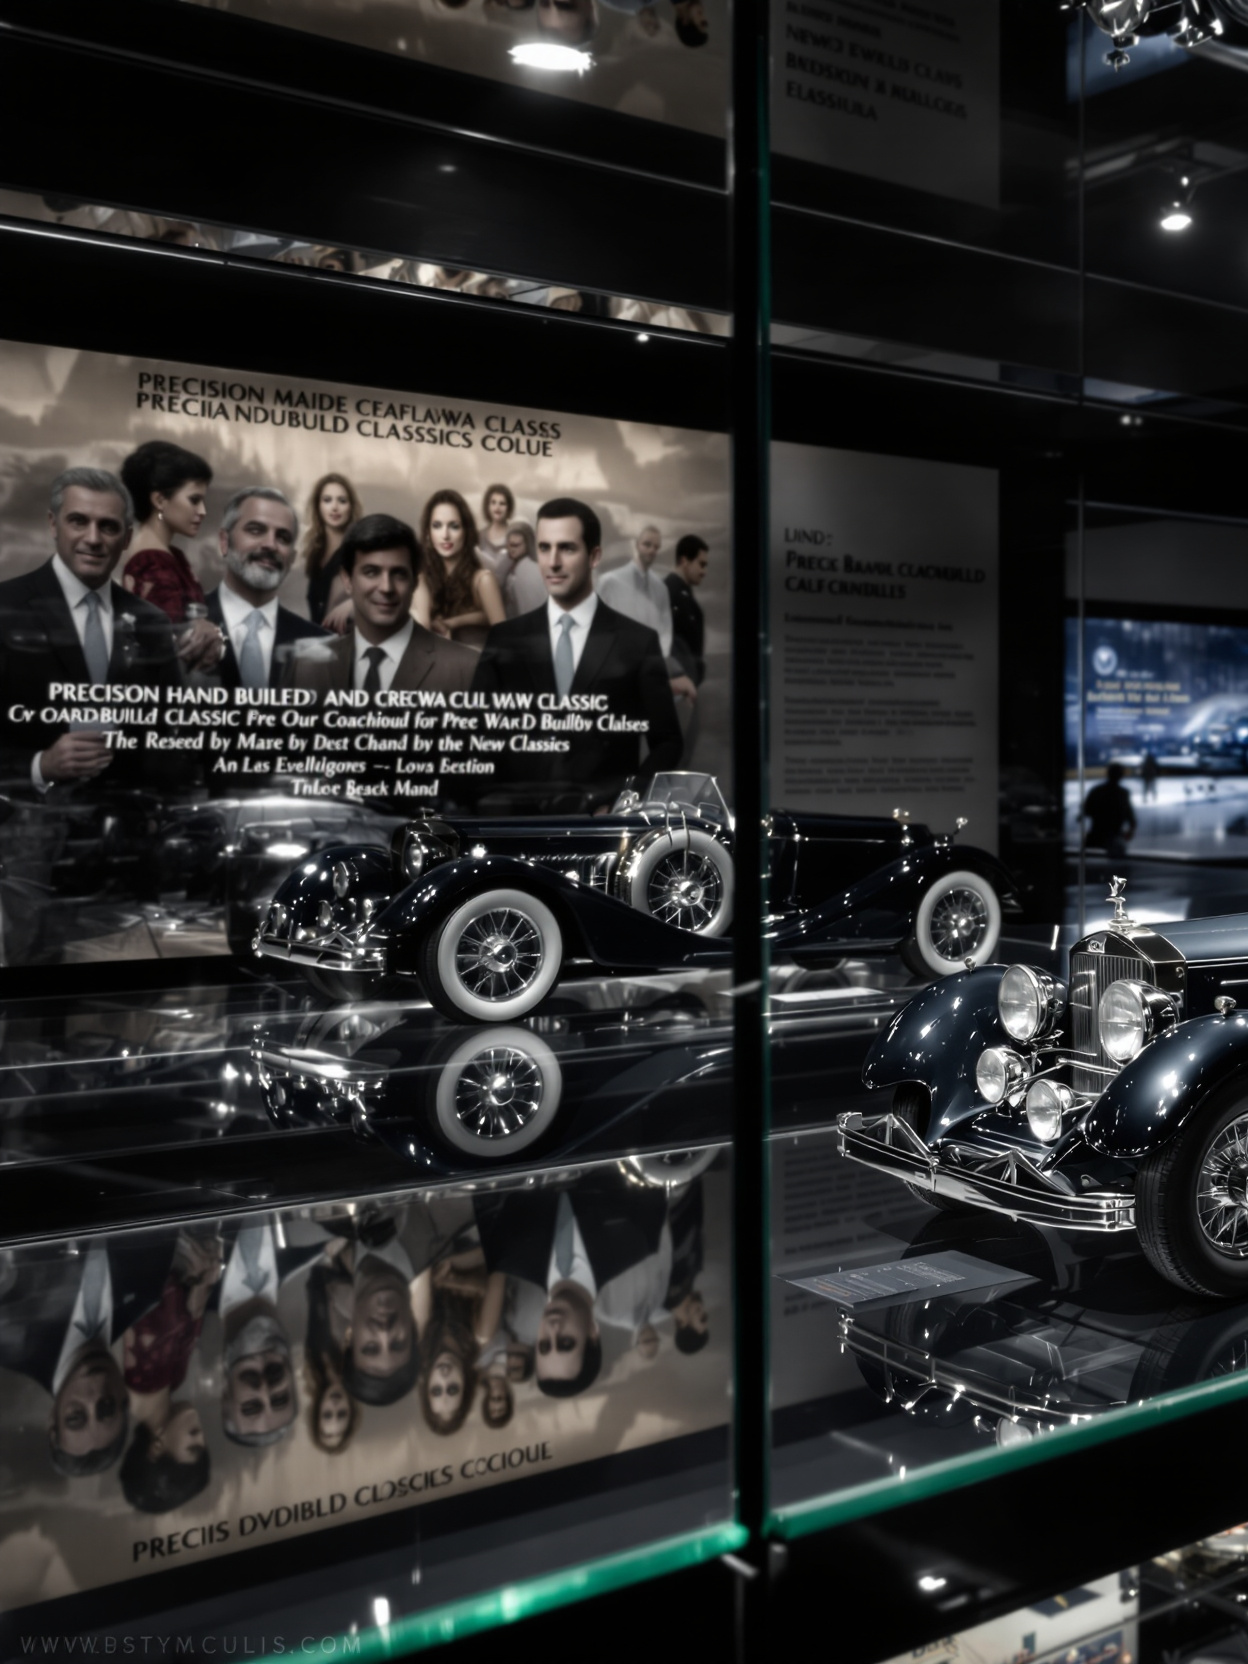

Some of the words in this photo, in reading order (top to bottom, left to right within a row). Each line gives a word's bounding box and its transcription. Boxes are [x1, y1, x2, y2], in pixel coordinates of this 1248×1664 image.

[138, 371, 265, 404] PRECISION
[273, 389, 348, 414] MAIDE
[356, 419, 473, 448] CLASSSICS
[481, 434, 553, 457] COLUE
[167, 686, 229, 705] HAND
[323, 689, 370, 707] AND
[537, 694, 609, 711] CLASSIC
[164, 708, 240, 726] CLASSIC
[281, 709, 319, 728] Our
[414, 711, 438, 729] for
[102, 730, 138, 750] The
[209, 731, 231, 753] by
[288, 733, 308, 753] by
[354, 733, 408, 751] Chand
[413, 734, 433, 753] by
[438, 735, 463, 752] the
[469, 735, 505, 752] New
[509, 734, 570, 752] Classics
[212, 756, 238, 774] An
[393, 779, 440, 797] Mand
